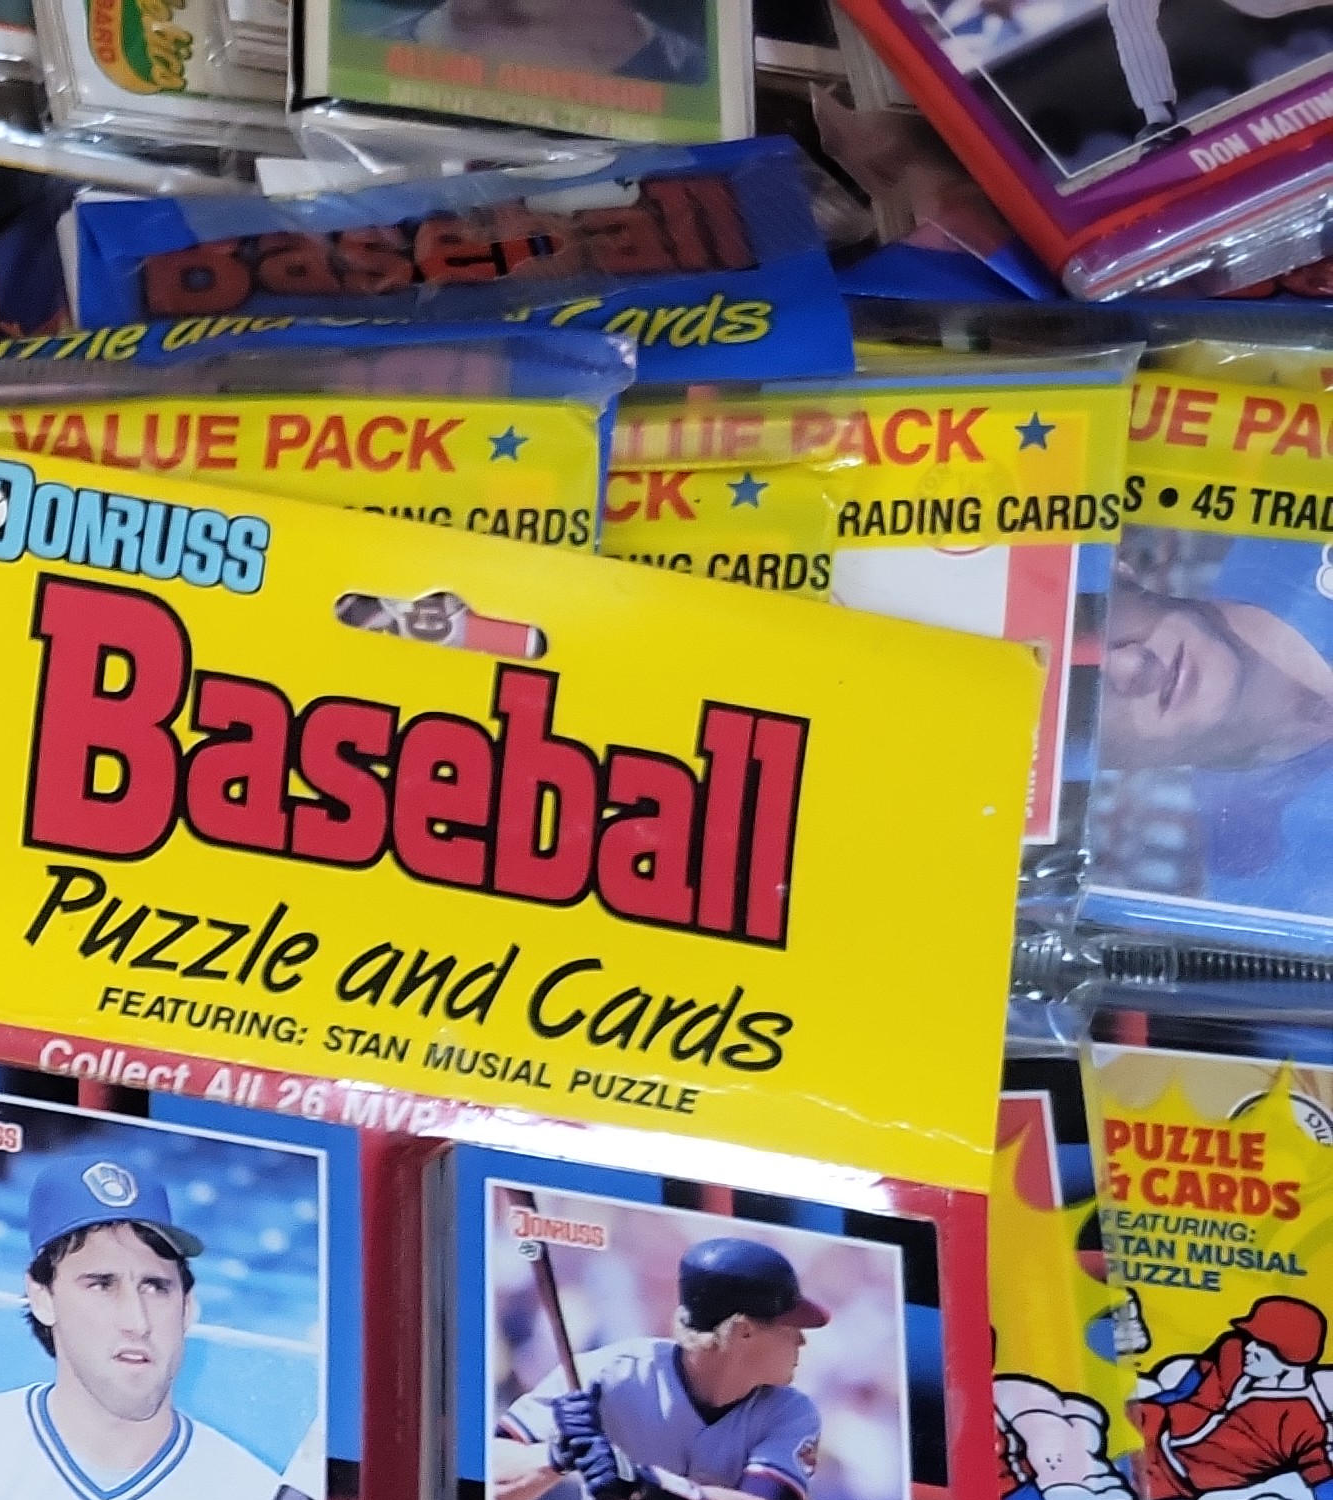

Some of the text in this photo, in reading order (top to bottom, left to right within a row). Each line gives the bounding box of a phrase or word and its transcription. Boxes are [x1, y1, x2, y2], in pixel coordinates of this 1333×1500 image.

[9, 413, 463, 472] VALUE PACK
[793, 406, 989, 466] PACK
[465, 507, 591, 546] CARDS
[995, 492, 1121, 533] CARDS
[1190, 482, 1233, 521] 45
[706, 552, 831, 593] CARDS
[22, 571, 811, 951] Baseball
[23, 865, 794, 1073] Puzzle and Cards
[98, 986, 702, 1116] FEATURING: STAN MUSIAL PUZZLE
[38, 1038, 190, 1095] Collect
[202, 1069, 265, 1109] All
[275, 1078, 327, 1121] 26
[341, 1089, 437, 1136] MVP
[1103, 1117, 1266, 1171] PUZZLE
[1139, 1166, 1302, 1221] CARDS
[514, 1208, 607, 1248] DONRUSS
[1099, 1208, 1257, 1243] FEATURING:
[1187, 1240, 1308, 1277] MUSIAL
